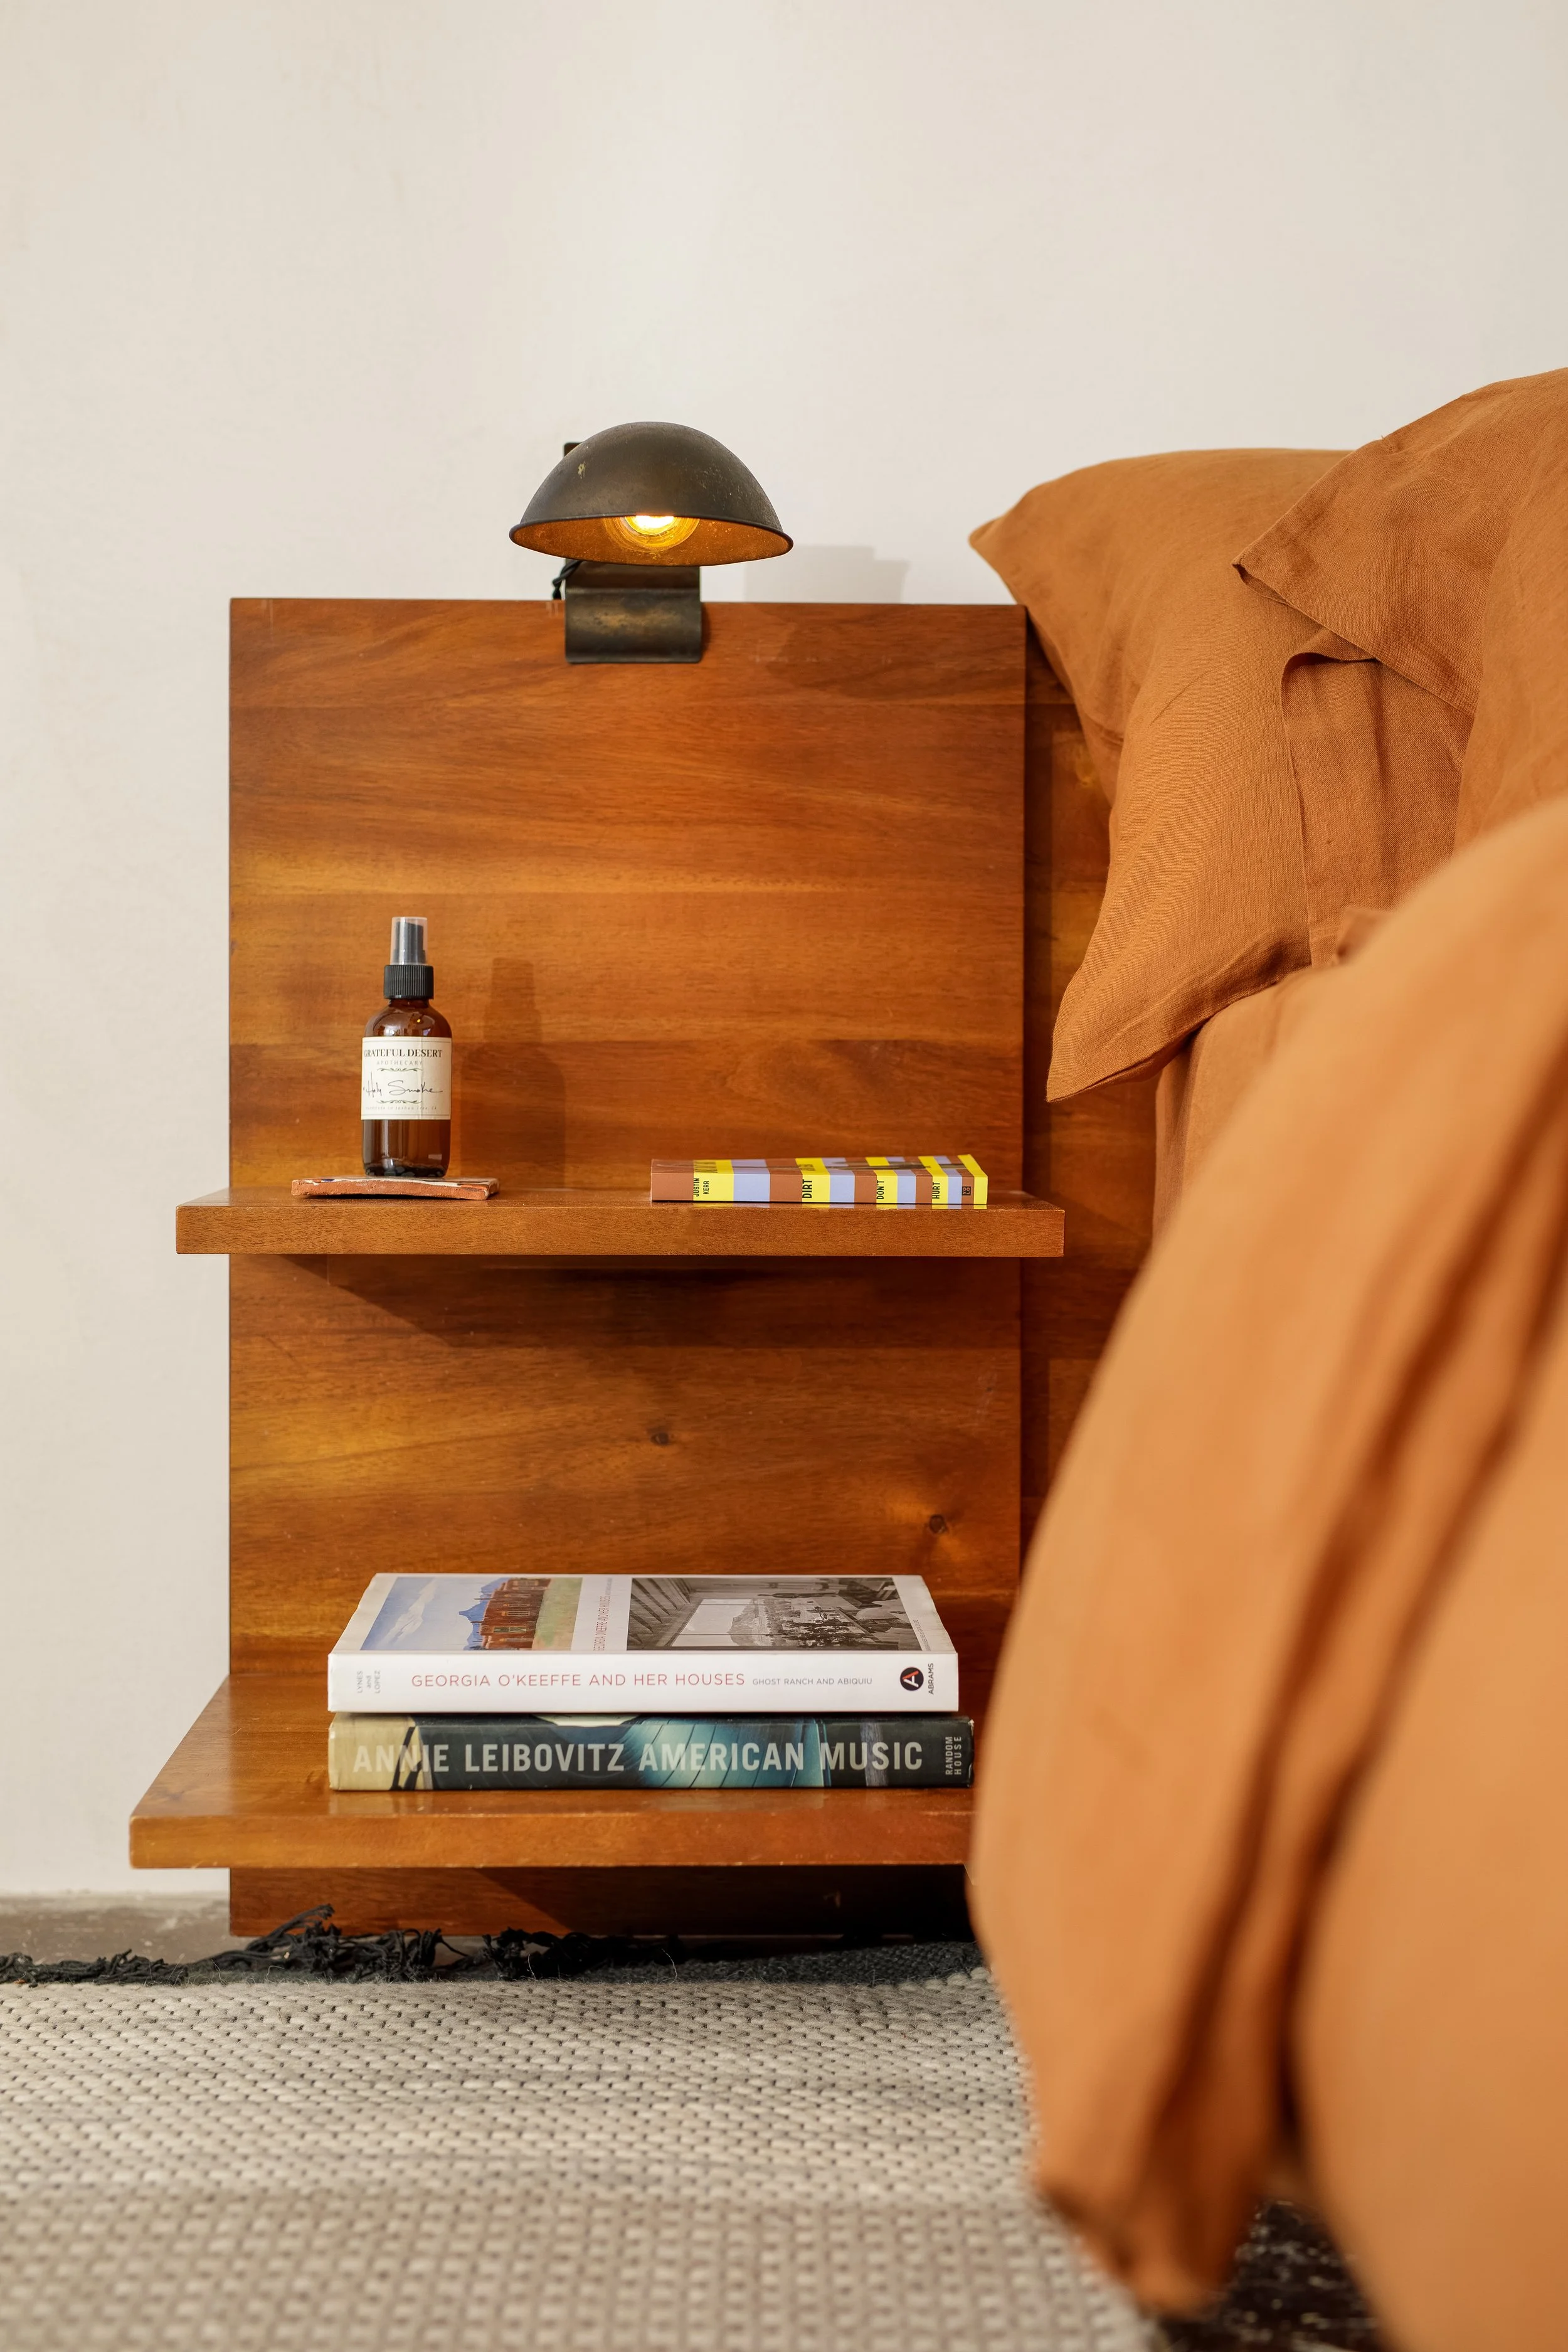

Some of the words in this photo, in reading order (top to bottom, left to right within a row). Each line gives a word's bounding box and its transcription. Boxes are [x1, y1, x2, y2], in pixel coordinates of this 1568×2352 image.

[364, 1049, 405, 1057] GRATEFUL
[408, 1049, 443, 1058] DESERT
[388, 1079, 443, 1096] Smoke
[802, 1179, 813, 1199] DIRT
[876, 1180, 885, 1200] DON'T
[932, 1182, 940, 1199] HURT
[411, 1675, 490, 1687] GEORGIA
[499, 1674, 581, 1687] O'KEEFFE
[590, 1674, 626, 1686] AND
[634, 1673, 668, 1686] HER
[675, 1673, 745, 1686] HOUSES
[837, 1677, 872, 1685] ABIQUIU
[352, 1744, 450, 1773] ANNIE
[465, 1743, 625, 1772] LEIBOVITZ
[638, 1742, 804, 1771] AMERICAN
[820, 1741, 923, 1771] MUSIC
[945, 1736, 953, 1776] RANDOM
[954, 1736, 962, 1776] HOUSE
